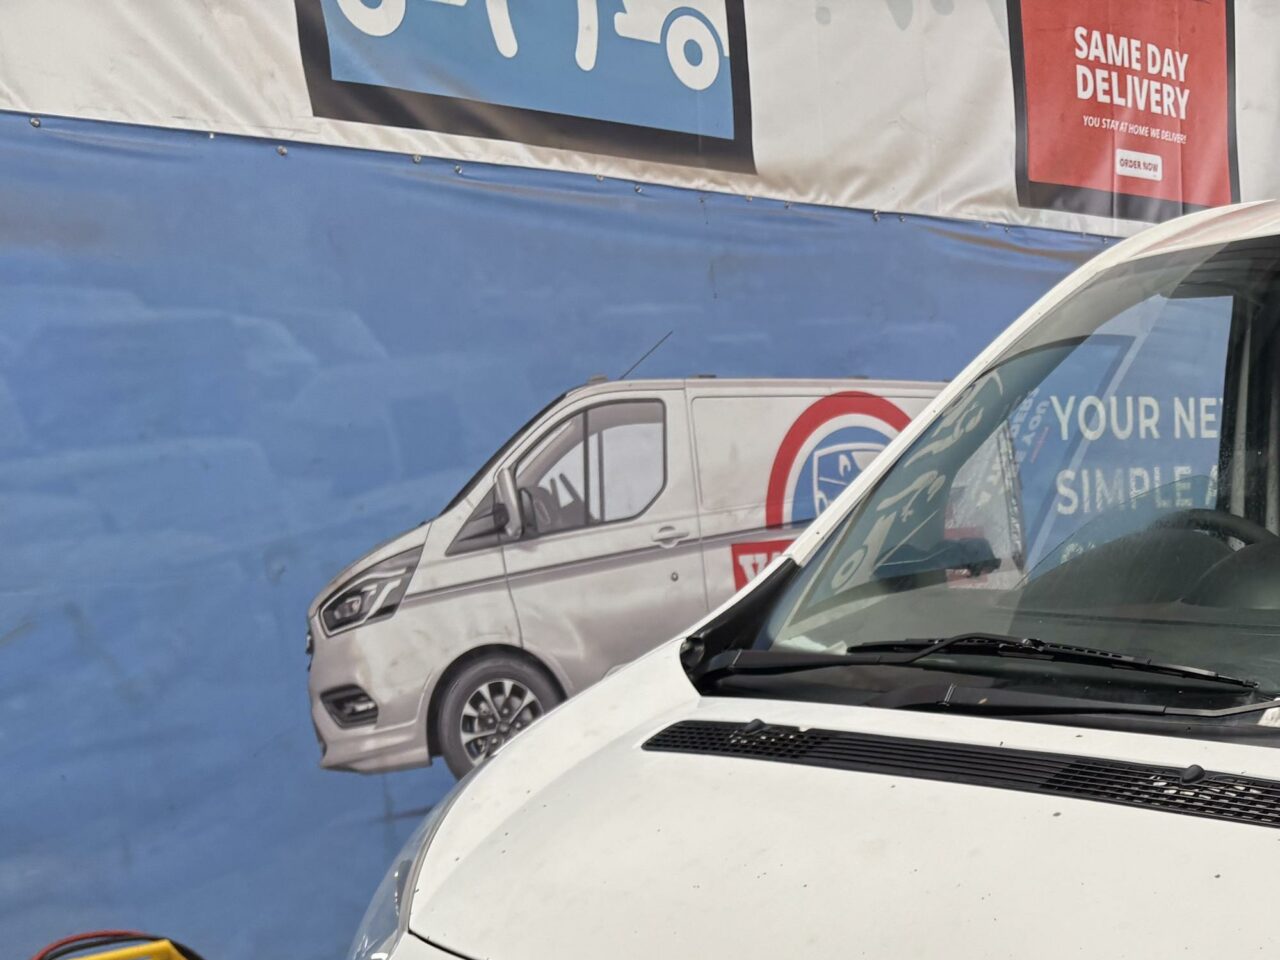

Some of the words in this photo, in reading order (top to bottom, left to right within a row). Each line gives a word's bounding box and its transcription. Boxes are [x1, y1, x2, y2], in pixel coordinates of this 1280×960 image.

[1074, 26, 1142, 71] SAME
[1147, 43, 1189, 82] DAY
[1076, 64, 1190, 119] DELIVERY
[1083, 115, 1100, 127] YOU
[1102, 118, 1119, 130] STAY
[1119, 120, 1128, 132] AT
[1128, 123, 1149, 136] HOME
[1150, 127, 1161, 139] WE
[1119, 158, 1142, 170] ORDER
[1143, 161, 1159, 173] NOW
[1050, 395, 1161, 441] YOUR
[1174, 395, 1223, 440] NE
[1056, 465, 1193, 516] SIMPLE
